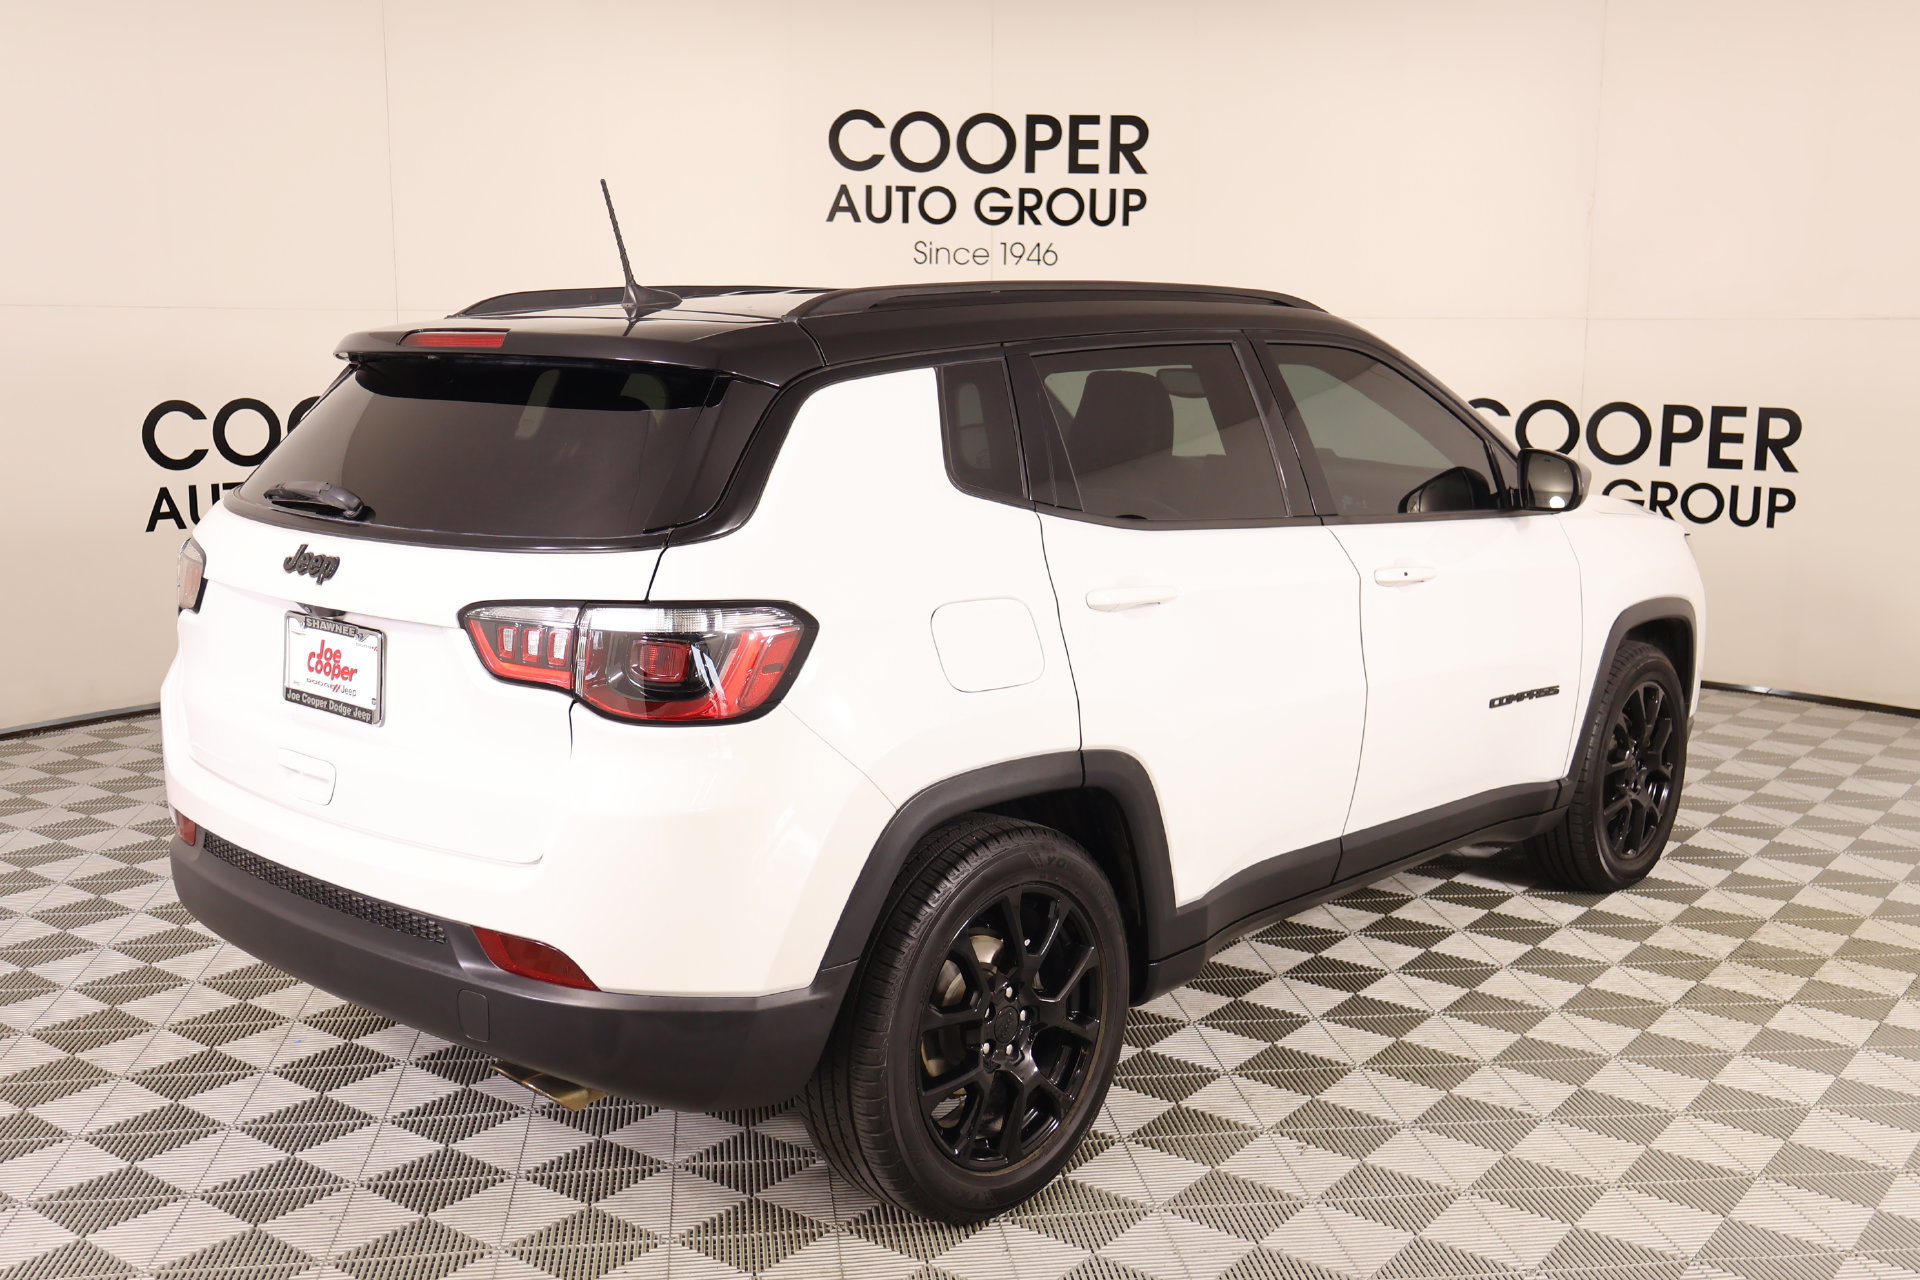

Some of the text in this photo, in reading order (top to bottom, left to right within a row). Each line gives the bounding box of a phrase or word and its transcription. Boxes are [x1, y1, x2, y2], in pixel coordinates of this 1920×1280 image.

[828, 108, 1149, 175] COOPER
[826, 184, 1148, 227] AUTO GROUP
[913, 240, 1059, 266] Since 1946
[142, 395, 321, 471] CO
[283, 544, 341, 586] Jeep
[305, 618, 356, 637] SHAWNEE
[307, 651, 358, 682] Cooper
[316, 639, 342, 663] Joe
[286, 689, 371, 722] Joe Cooper Dodge Jeep
[340, 685, 357, 698] Jeep
[1489, 685, 1560, 709] COMPASS
